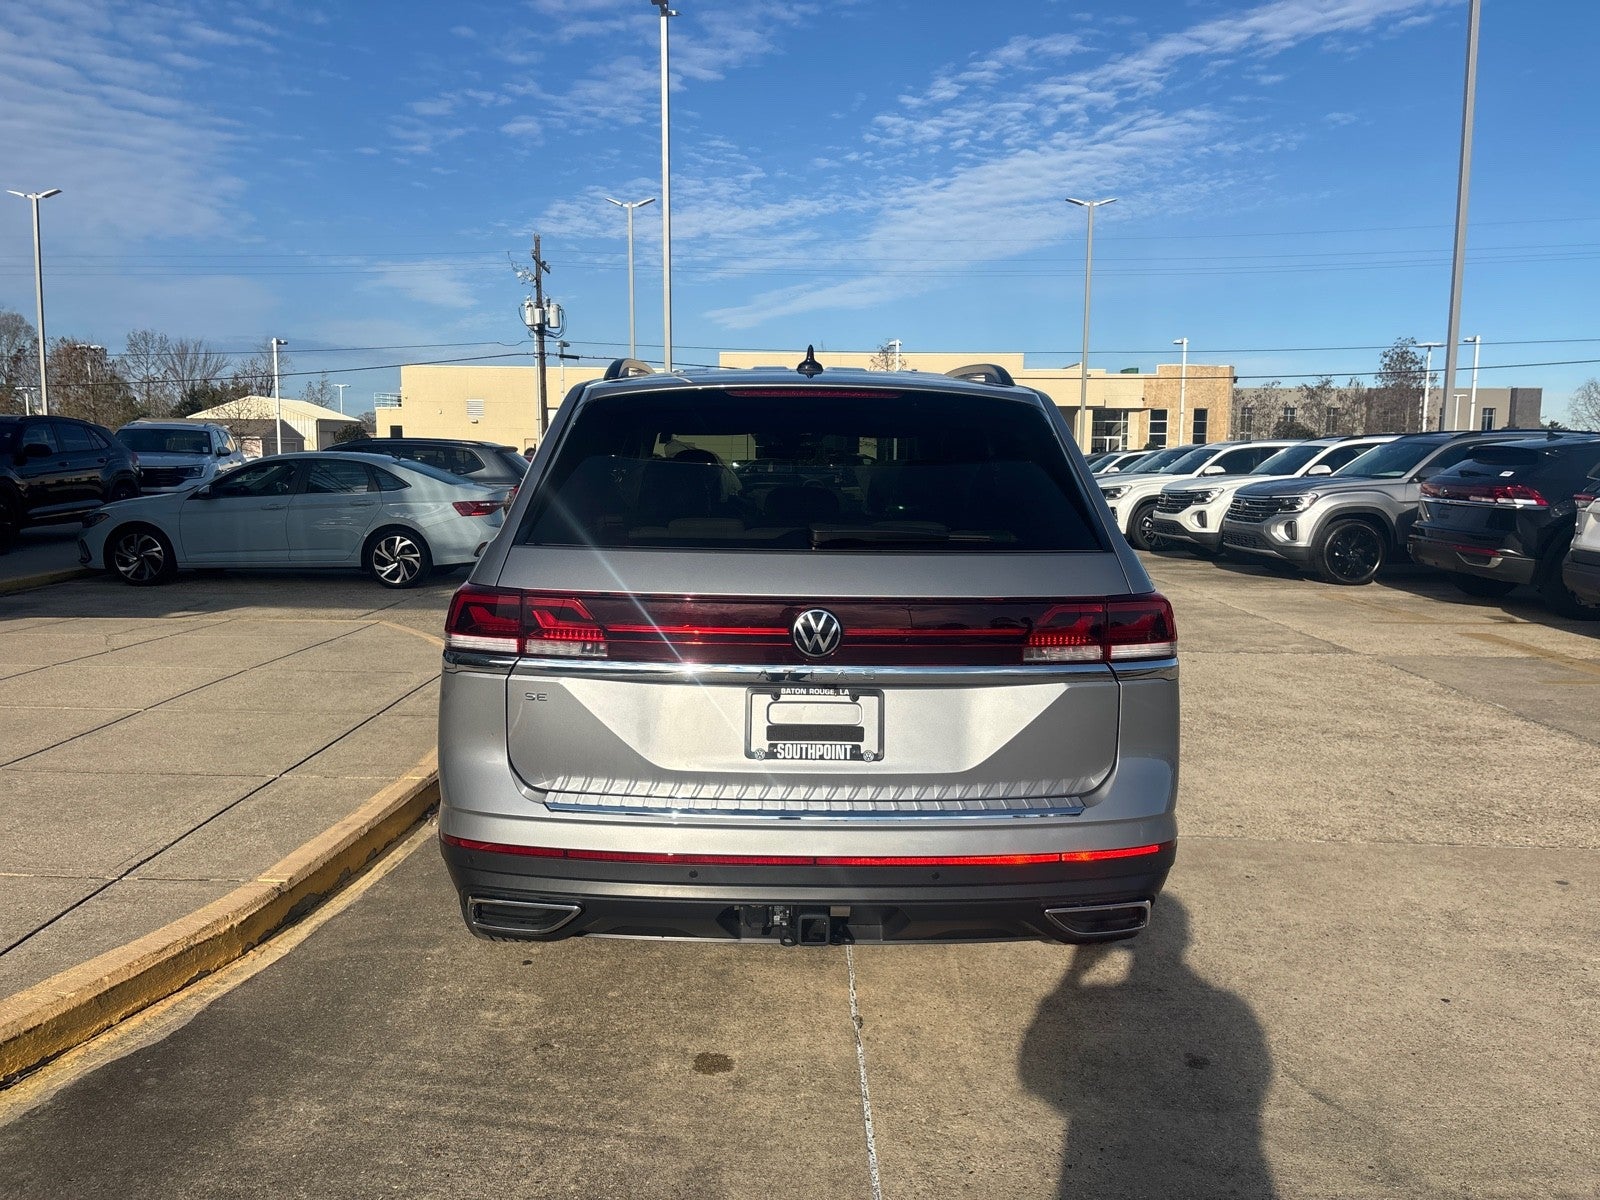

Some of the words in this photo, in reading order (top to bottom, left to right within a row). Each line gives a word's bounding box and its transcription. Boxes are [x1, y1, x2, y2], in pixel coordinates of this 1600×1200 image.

[794, 609, 841, 657] VW
[524, 692, 548, 702] SE
[780, 687, 807, 695] BATON
[809, 688, 838, 697] ROUGE,
[776, 743, 852, 760] SOUTHPOINT
